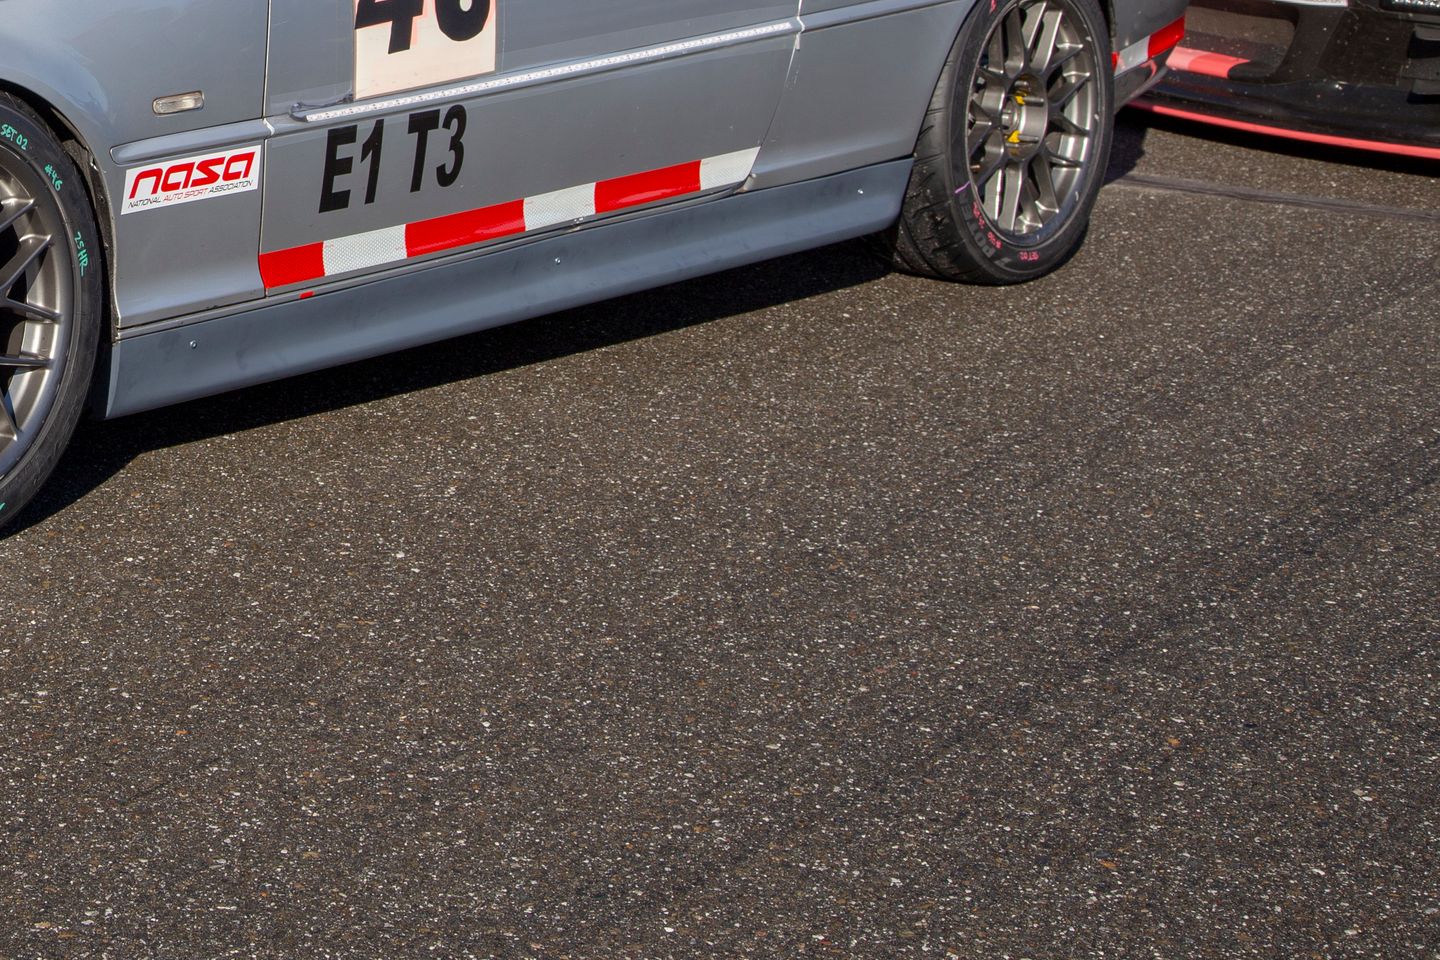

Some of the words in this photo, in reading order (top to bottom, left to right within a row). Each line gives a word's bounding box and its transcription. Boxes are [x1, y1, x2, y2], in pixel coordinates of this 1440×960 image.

[0, 124, 17, 141] SET
[319, 119, 385, 214] E1
[408, 104, 467, 193] T3
[44, 164, 63, 191] #46
[127, 197, 161, 209] NATIONAL
[163, 192, 182, 201] AUTO
[183, 188, 209, 199] SPORT
[208, 180, 253, 193] ASSOCIATION
